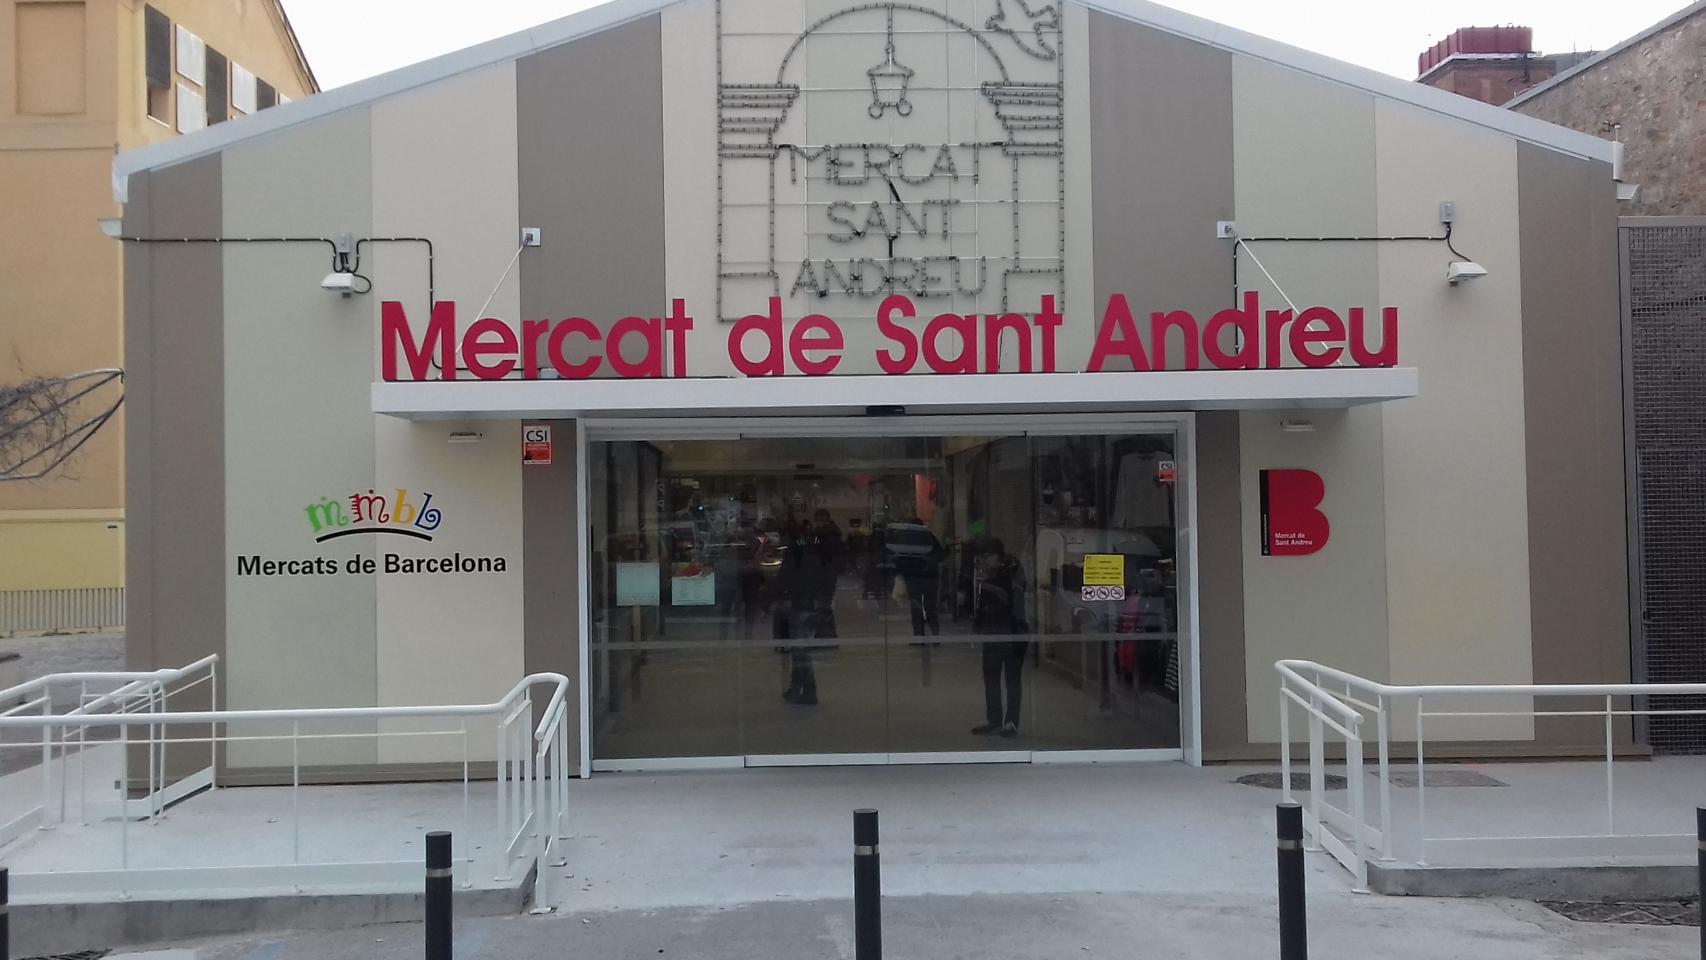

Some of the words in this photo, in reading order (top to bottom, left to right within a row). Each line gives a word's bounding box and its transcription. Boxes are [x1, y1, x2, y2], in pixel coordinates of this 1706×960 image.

[790, 143, 996, 185] MERCAT
[827, 200, 961, 242] SANT
[790, 255, 986, 298] ANDREU
[380, 297, 694, 381] Mercat
[727, 296, 844, 377] de
[875, 294, 1063, 374] Sant
[1086, 291, 1398, 372] Andreu
[526, 430, 548, 442] CSI
[236, 555, 338, 576] Mercats
[346, 554, 376, 574] de
[384, 552, 507, 573] Barcelona
